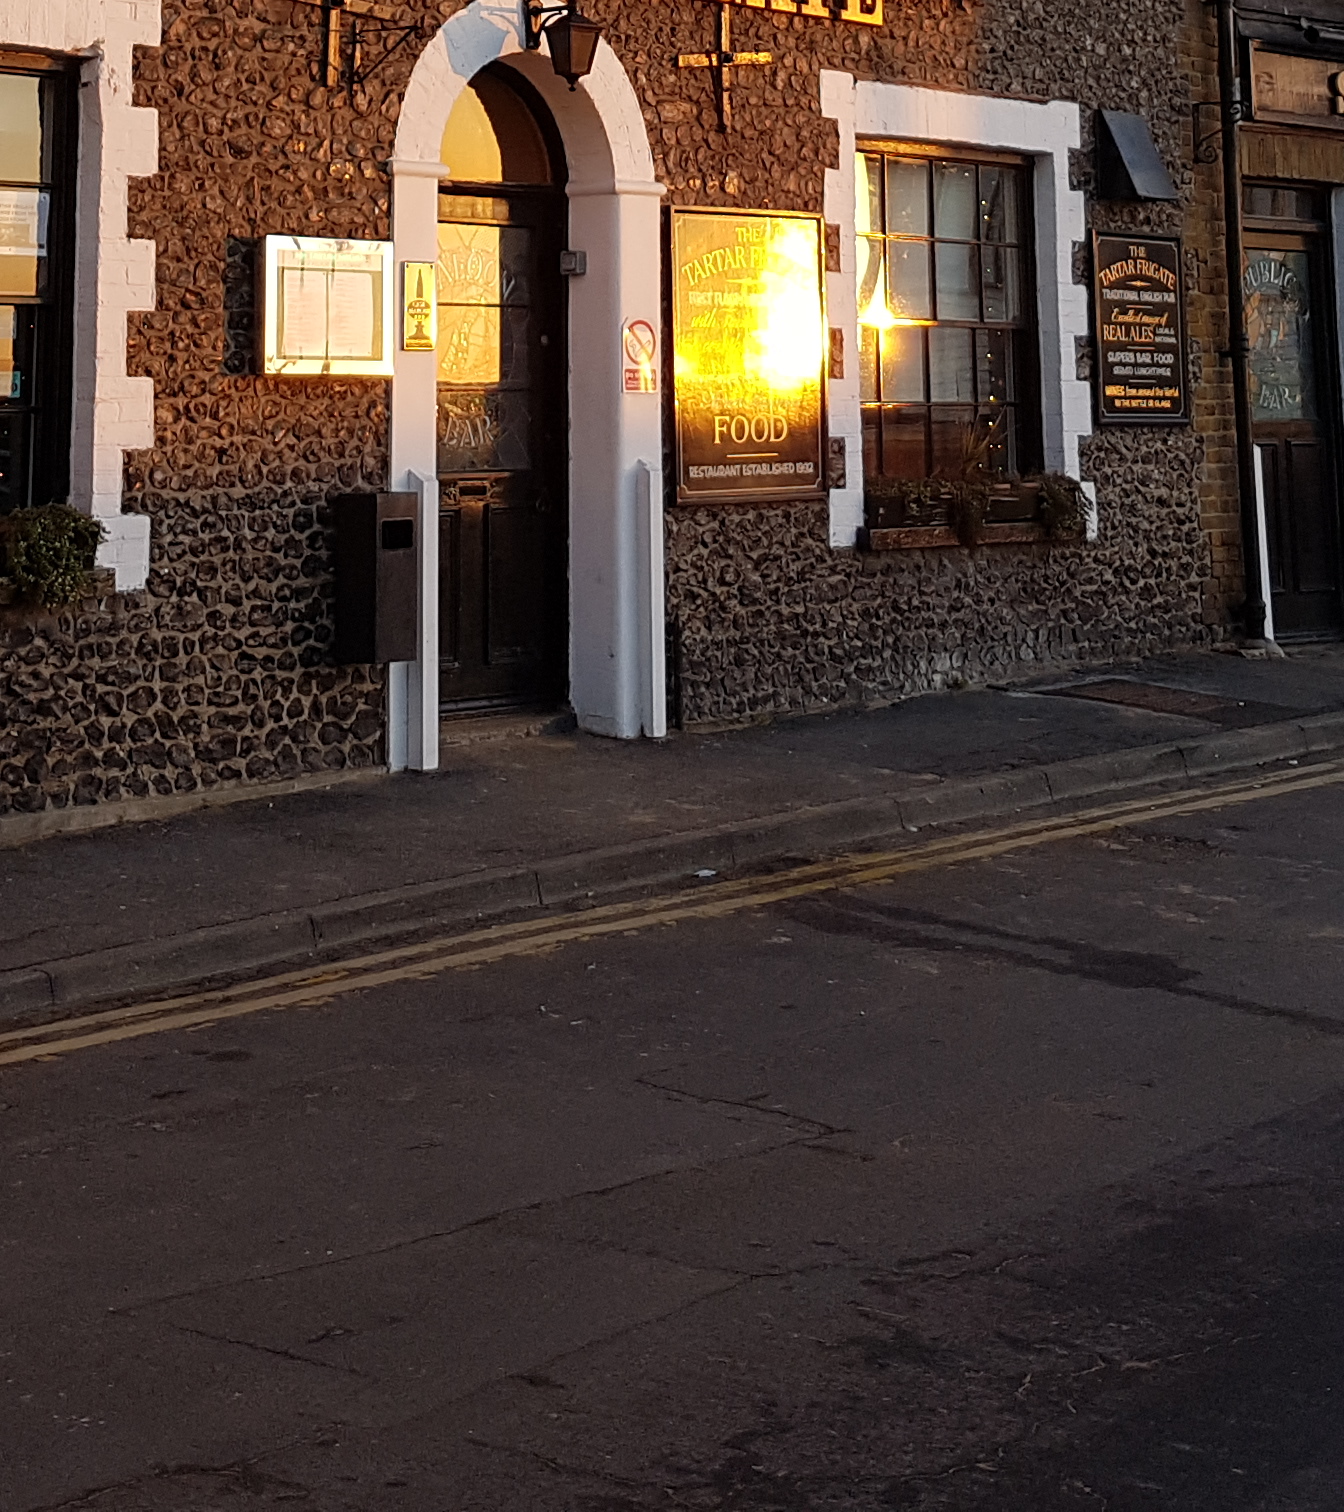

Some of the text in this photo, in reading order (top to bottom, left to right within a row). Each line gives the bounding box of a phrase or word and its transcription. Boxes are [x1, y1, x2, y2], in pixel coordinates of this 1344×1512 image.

[735, 227, 761, 243] THE
[1128, 245, 1147, 258] THE
[681, 245, 748, 287] TARTAR
[1098, 258, 1176, 291] TARTAR FRIGATE
[1103, 324, 1154, 342] REAL ALES
[1107, 351, 1174, 364] SUPERB BAR FOOD
[1259, 384, 1294, 410] BAR
[443, 414, 495, 449] BAR
[713, 414, 789, 445] FOOD
[688, 463, 742, 479] RESTAURANT
[742, 462, 795, 476] ESTABLISHED
